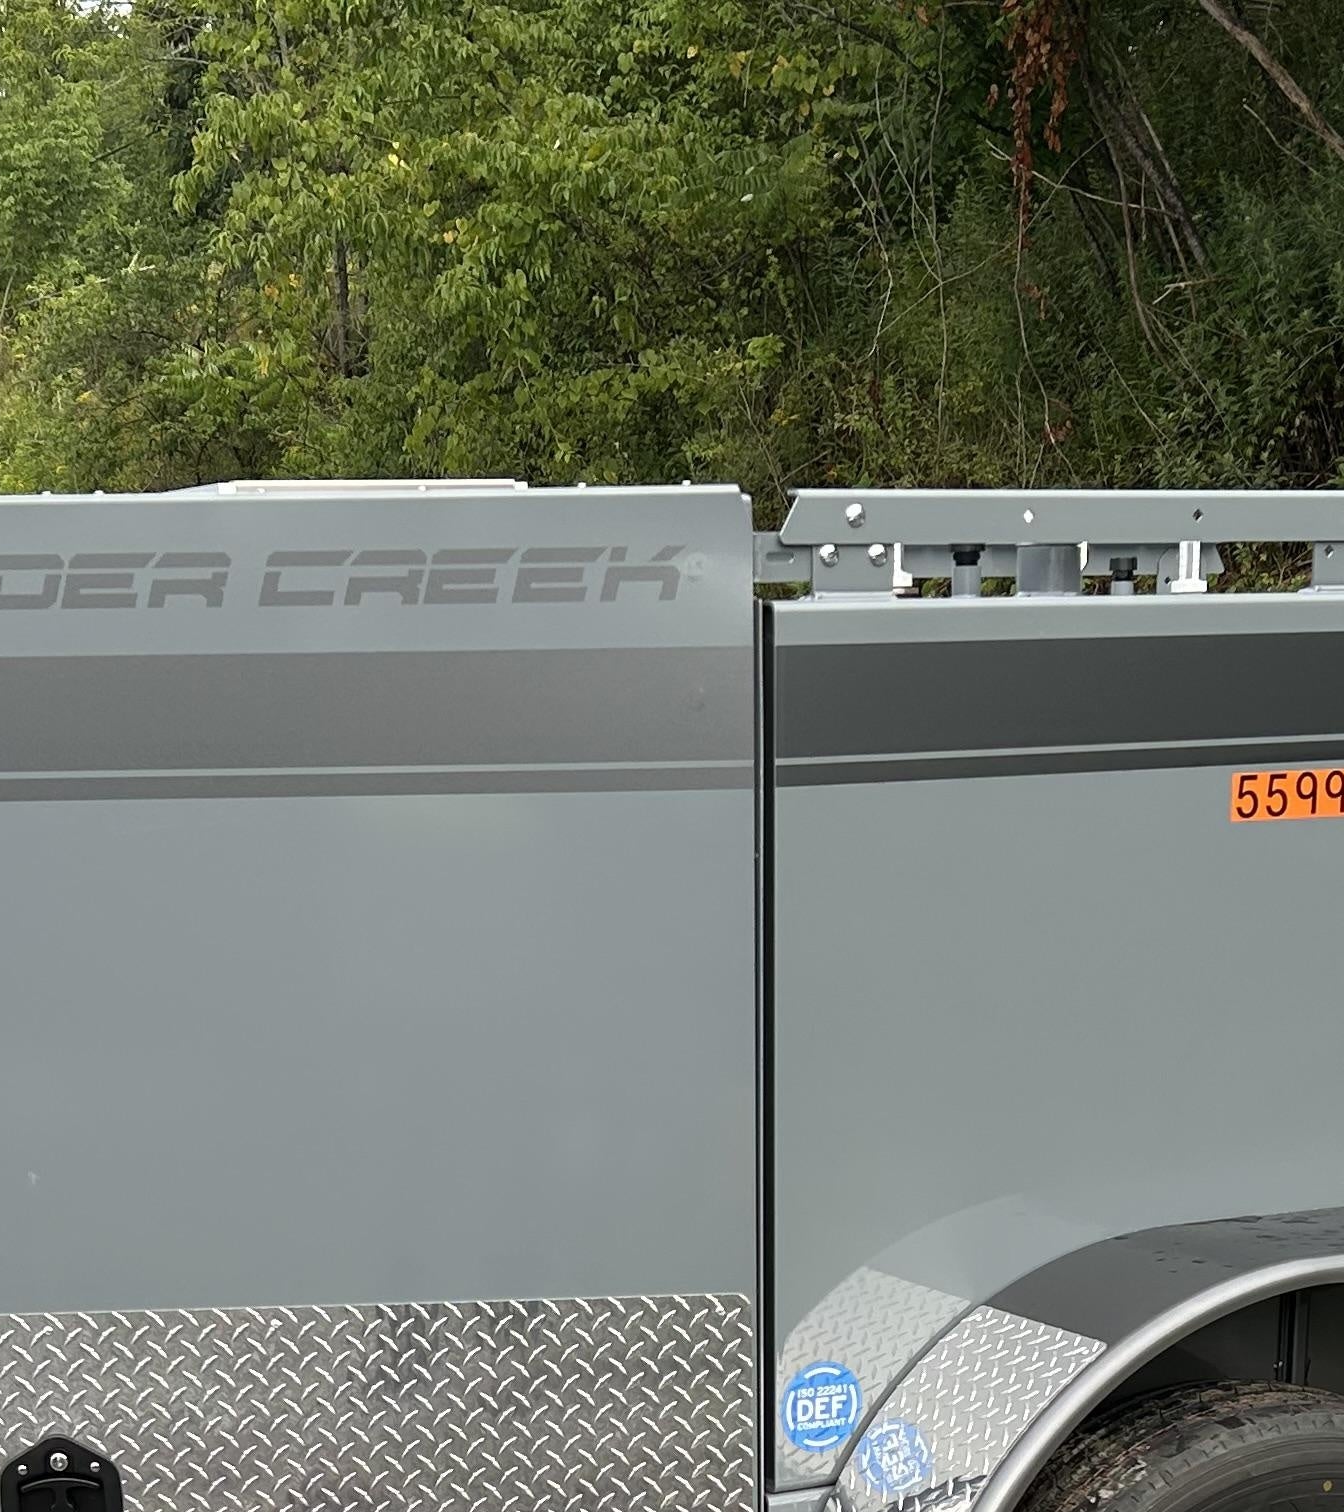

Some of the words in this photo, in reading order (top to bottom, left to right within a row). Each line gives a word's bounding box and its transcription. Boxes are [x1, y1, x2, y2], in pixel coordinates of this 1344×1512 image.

[257, 545, 687, 608] CREEK
[797, 1387, 815, 1399] ISO
[816, 1383, 849, 1398] 22241
[796, 1394, 847, 1423] DEF
[796, 1418, 847, 1432] COMPLIANT
